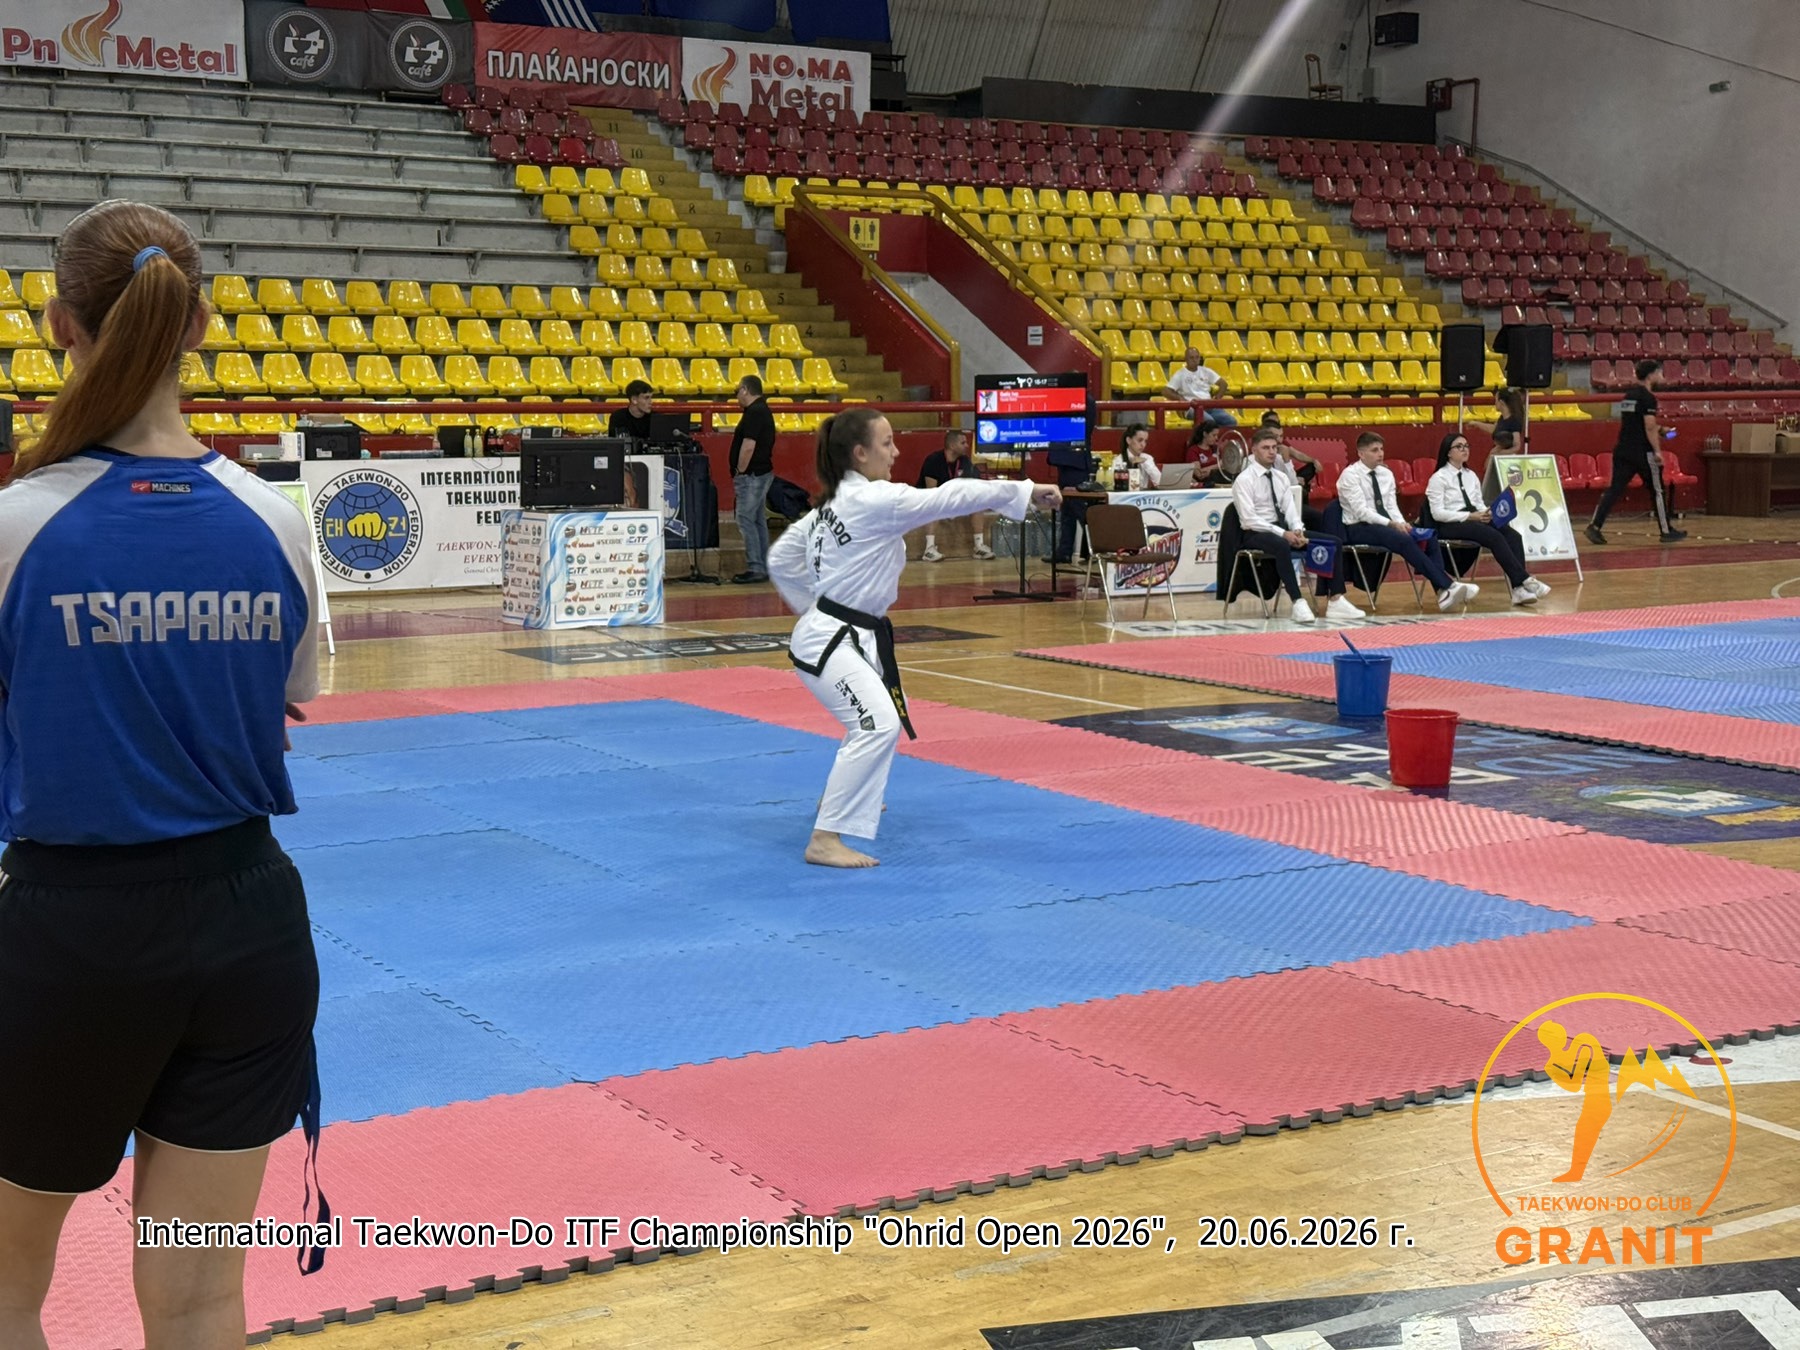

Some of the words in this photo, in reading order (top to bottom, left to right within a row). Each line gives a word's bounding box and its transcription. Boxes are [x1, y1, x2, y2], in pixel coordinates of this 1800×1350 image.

[2, 27, 58, 62] Pn
[115, 35, 238, 73] Metal
[289, 56, 315, 70] café
[487, 48, 671, 90] ПЛАЌАНОСКИ
[749, 53, 853, 82] NO.MA
[408, 65, 433, 78] café
[751, 79, 855, 112] Metal
[608, 122, 619, 133] 11
[630, 148, 643, 159] 10
[658, 174, 665, 186] 9
[688, 202, 696, 214] 8
[715, 231, 722, 242] 7
[744, 260, 752, 273] 6
[777, 292, 785, 305] 5
[805, 324, 815, 338] 4
[840, 358, 847, 372] 3
[1136, 497, 1160, 508] Ohrid
[1162, 500, 1180, 520] Open
[1523, 489, 1548, 533] 3
[333, 473, 409, 501] TAEKWON-DO
[384, 510, 419, 576] FEDERATION
[464, 555, 501, 564] EVERY
[51, 591, 281, 646] TSAPARA
